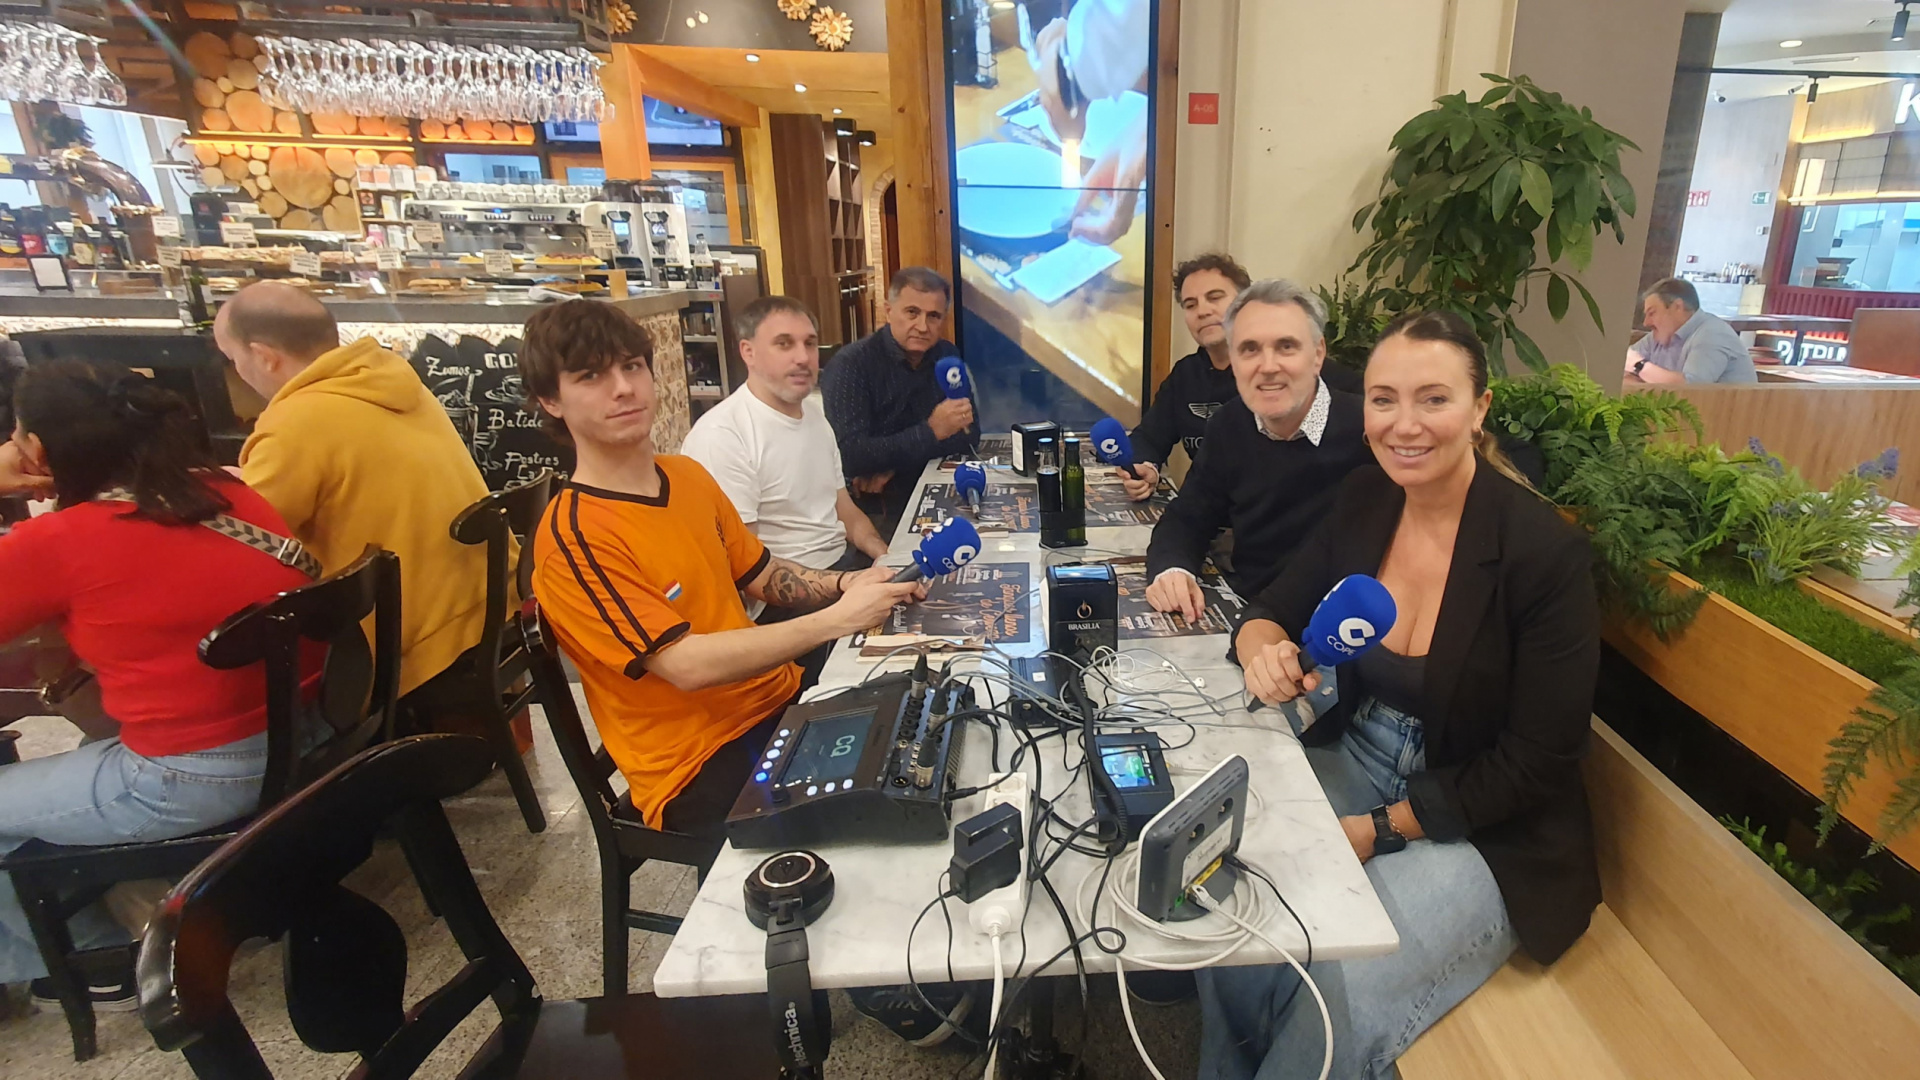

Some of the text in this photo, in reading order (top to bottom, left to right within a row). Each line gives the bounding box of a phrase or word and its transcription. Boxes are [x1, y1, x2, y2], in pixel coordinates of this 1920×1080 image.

[425, 356, 471, 377] Zumos
[484, 353, 518, 369] GO
[505, 452, 560, 470] Postres
[1327, 635, 1356, 656] COPE
